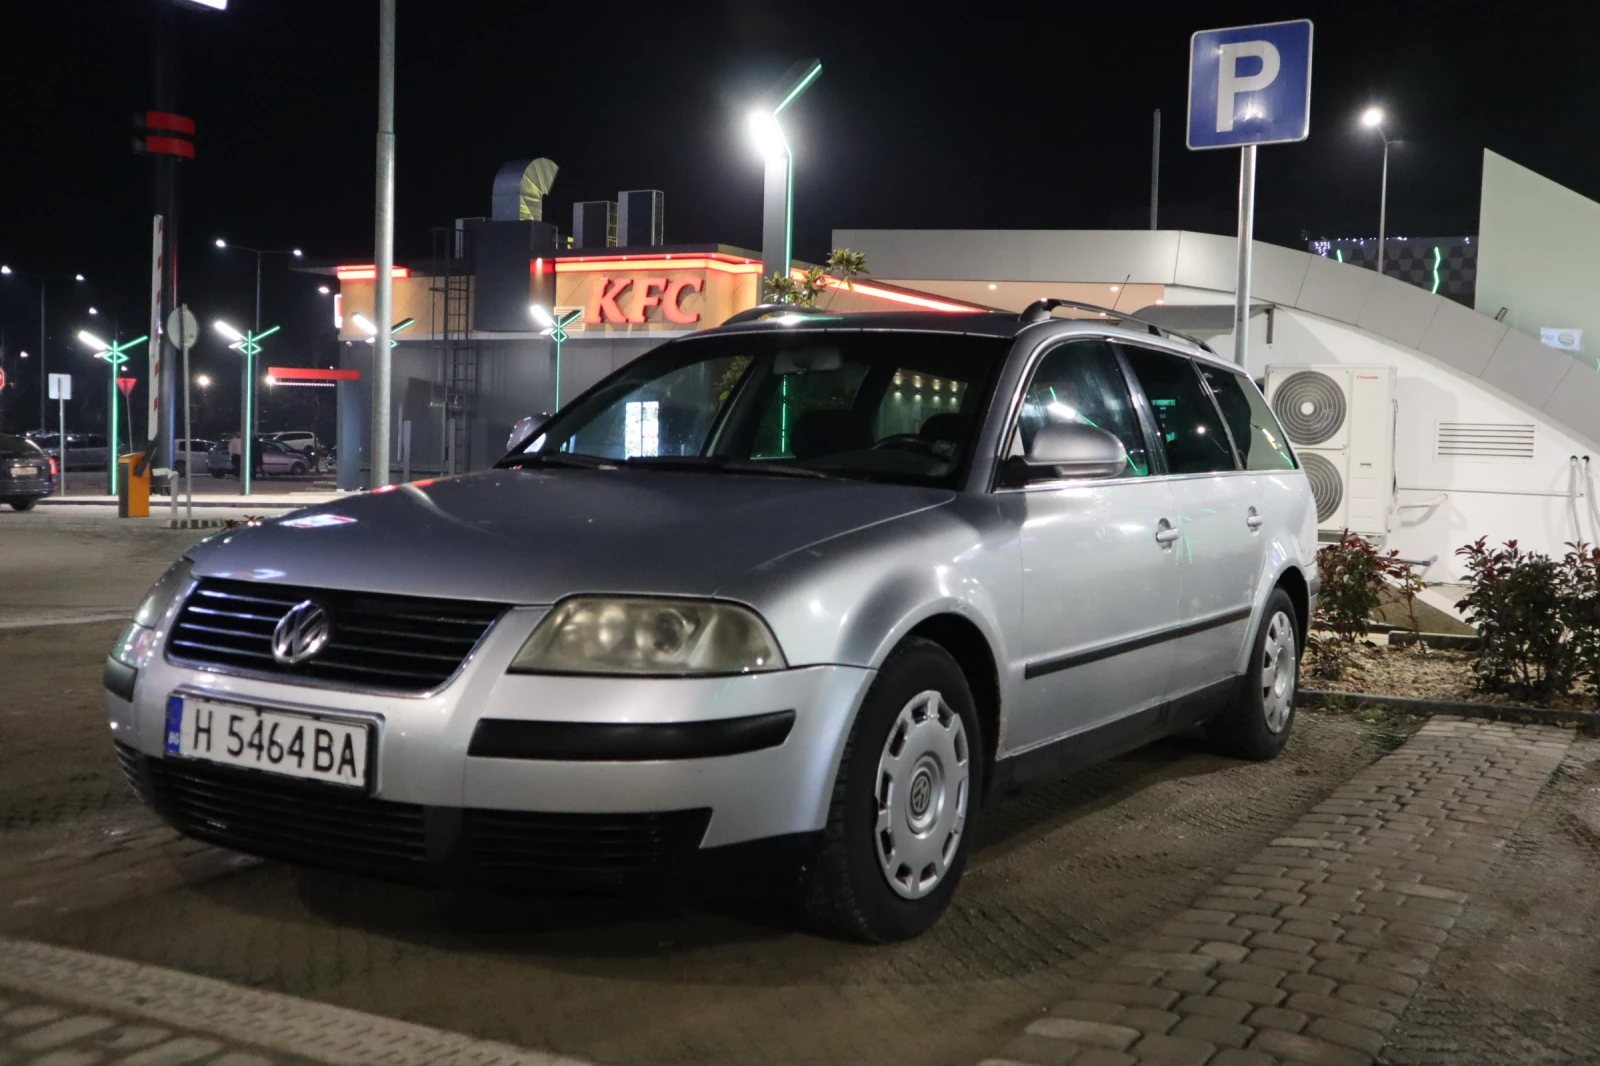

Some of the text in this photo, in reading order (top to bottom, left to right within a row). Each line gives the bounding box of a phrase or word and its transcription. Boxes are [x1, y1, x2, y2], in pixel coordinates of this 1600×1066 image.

[1216, 40, 1280, 133] P
[583, 277, 704, 324] KFC
[167, 731, 180, 745] BG
[193, 708, 213, 752] H
